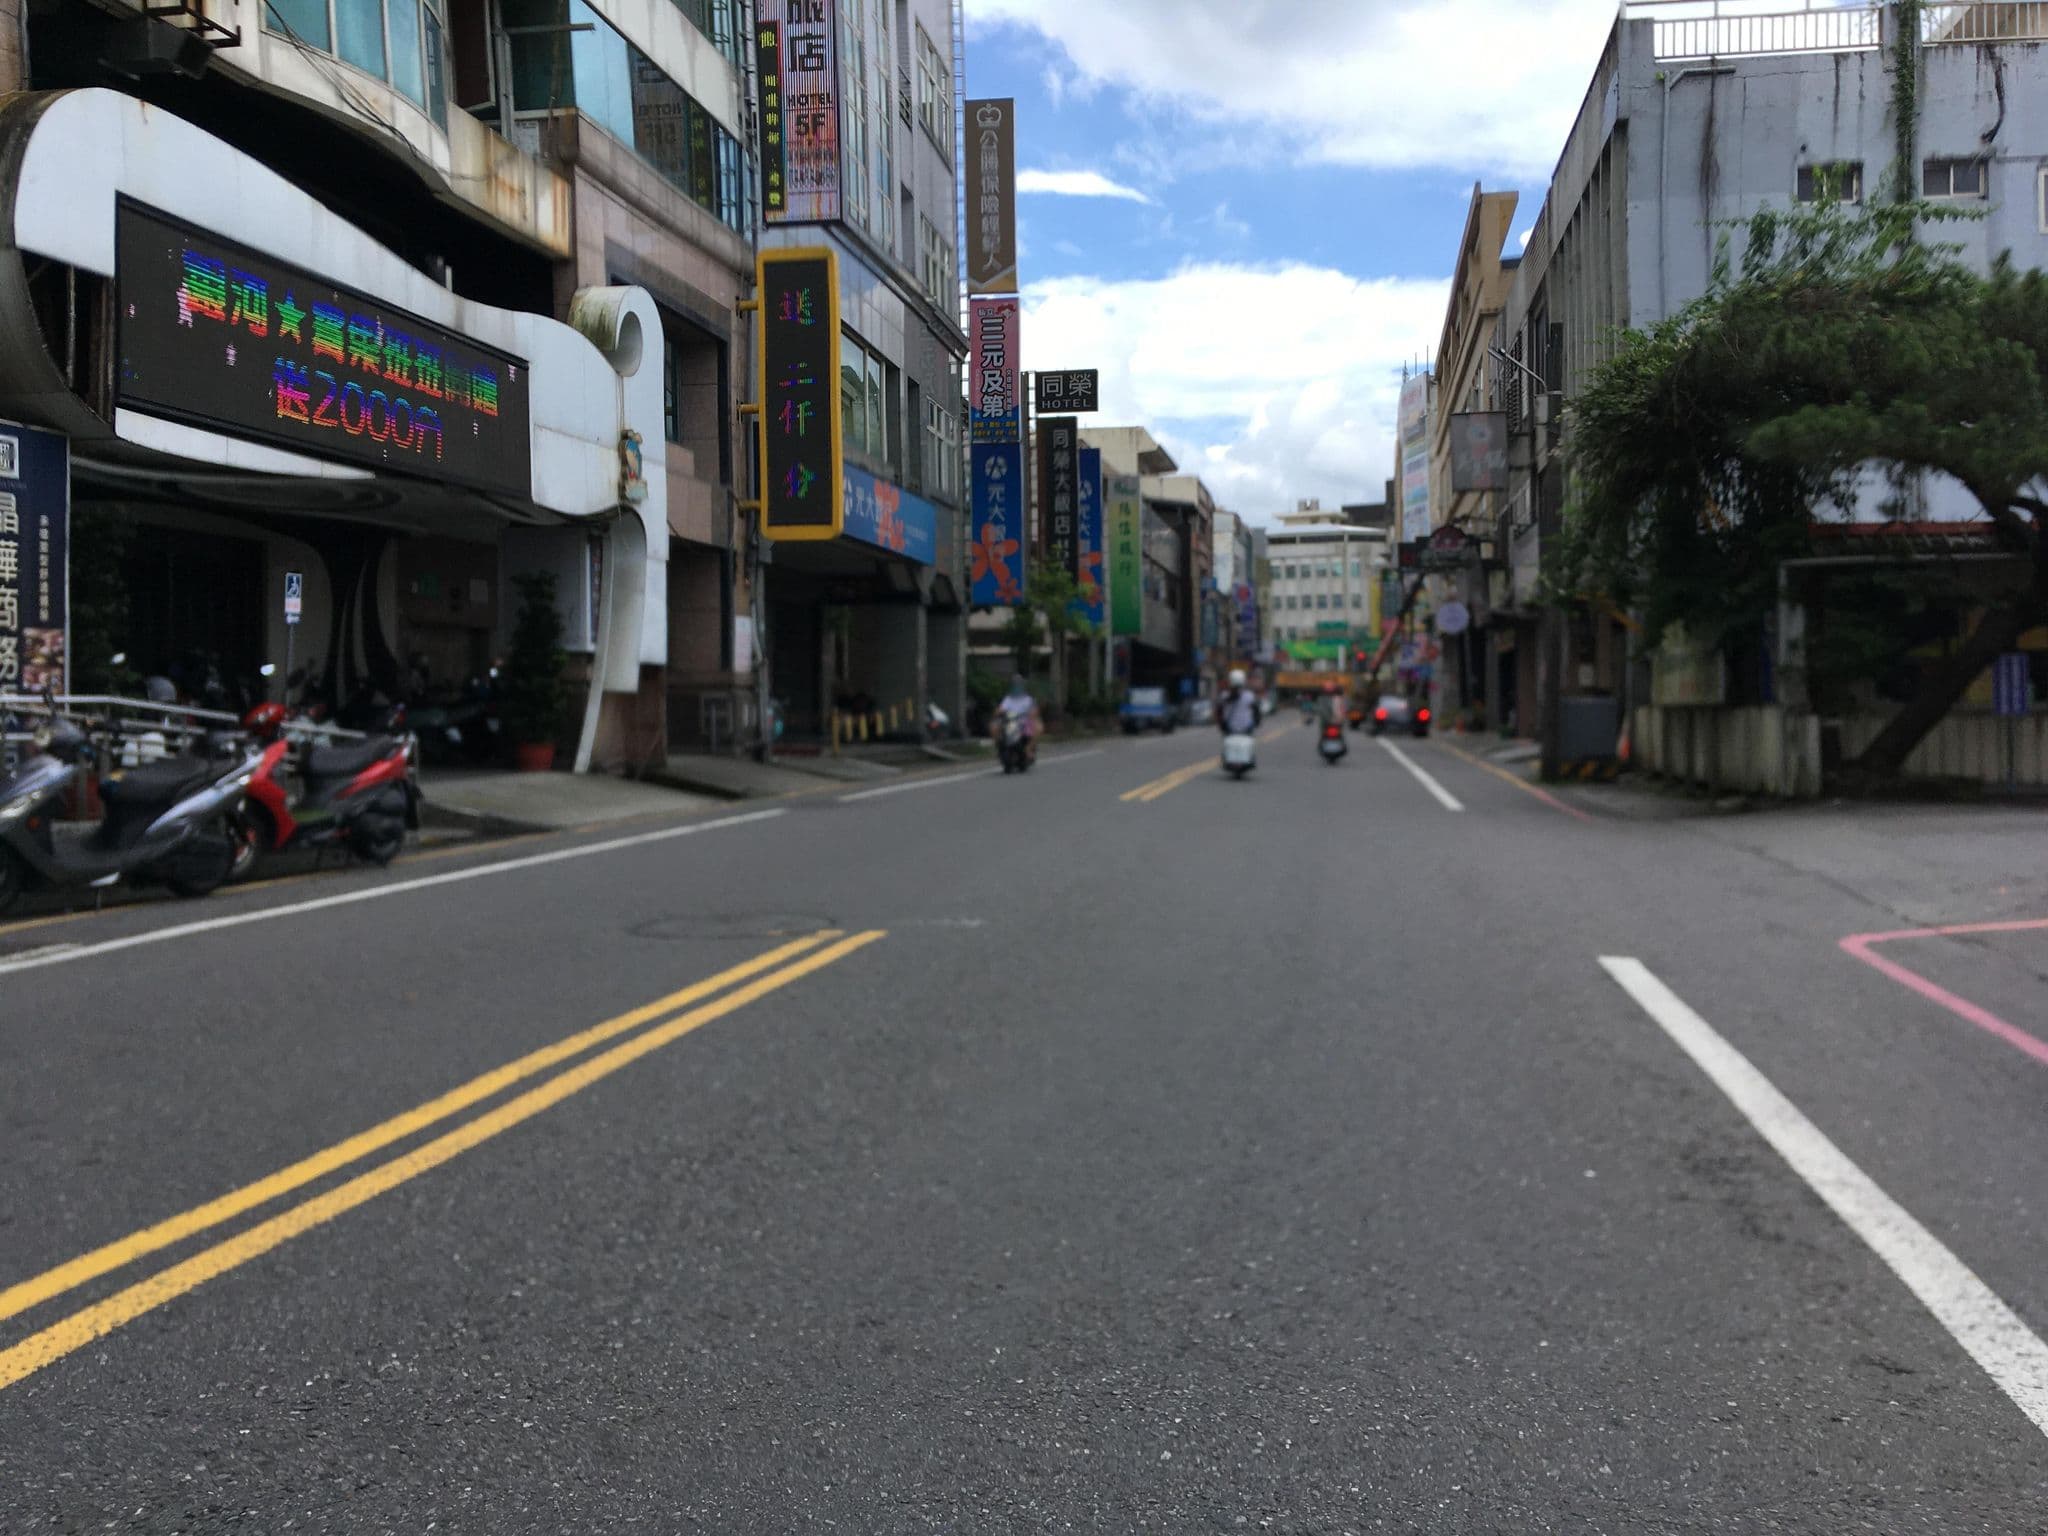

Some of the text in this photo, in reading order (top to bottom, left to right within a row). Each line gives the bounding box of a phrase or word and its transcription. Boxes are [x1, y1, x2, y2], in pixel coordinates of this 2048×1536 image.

[786, 92, 834, 108] HOTEL
[796, 112, 826, 137] 5F
[1041, 373, 1092, 398] 同榮
[1041, 399, 1091, 409] HOTEL
